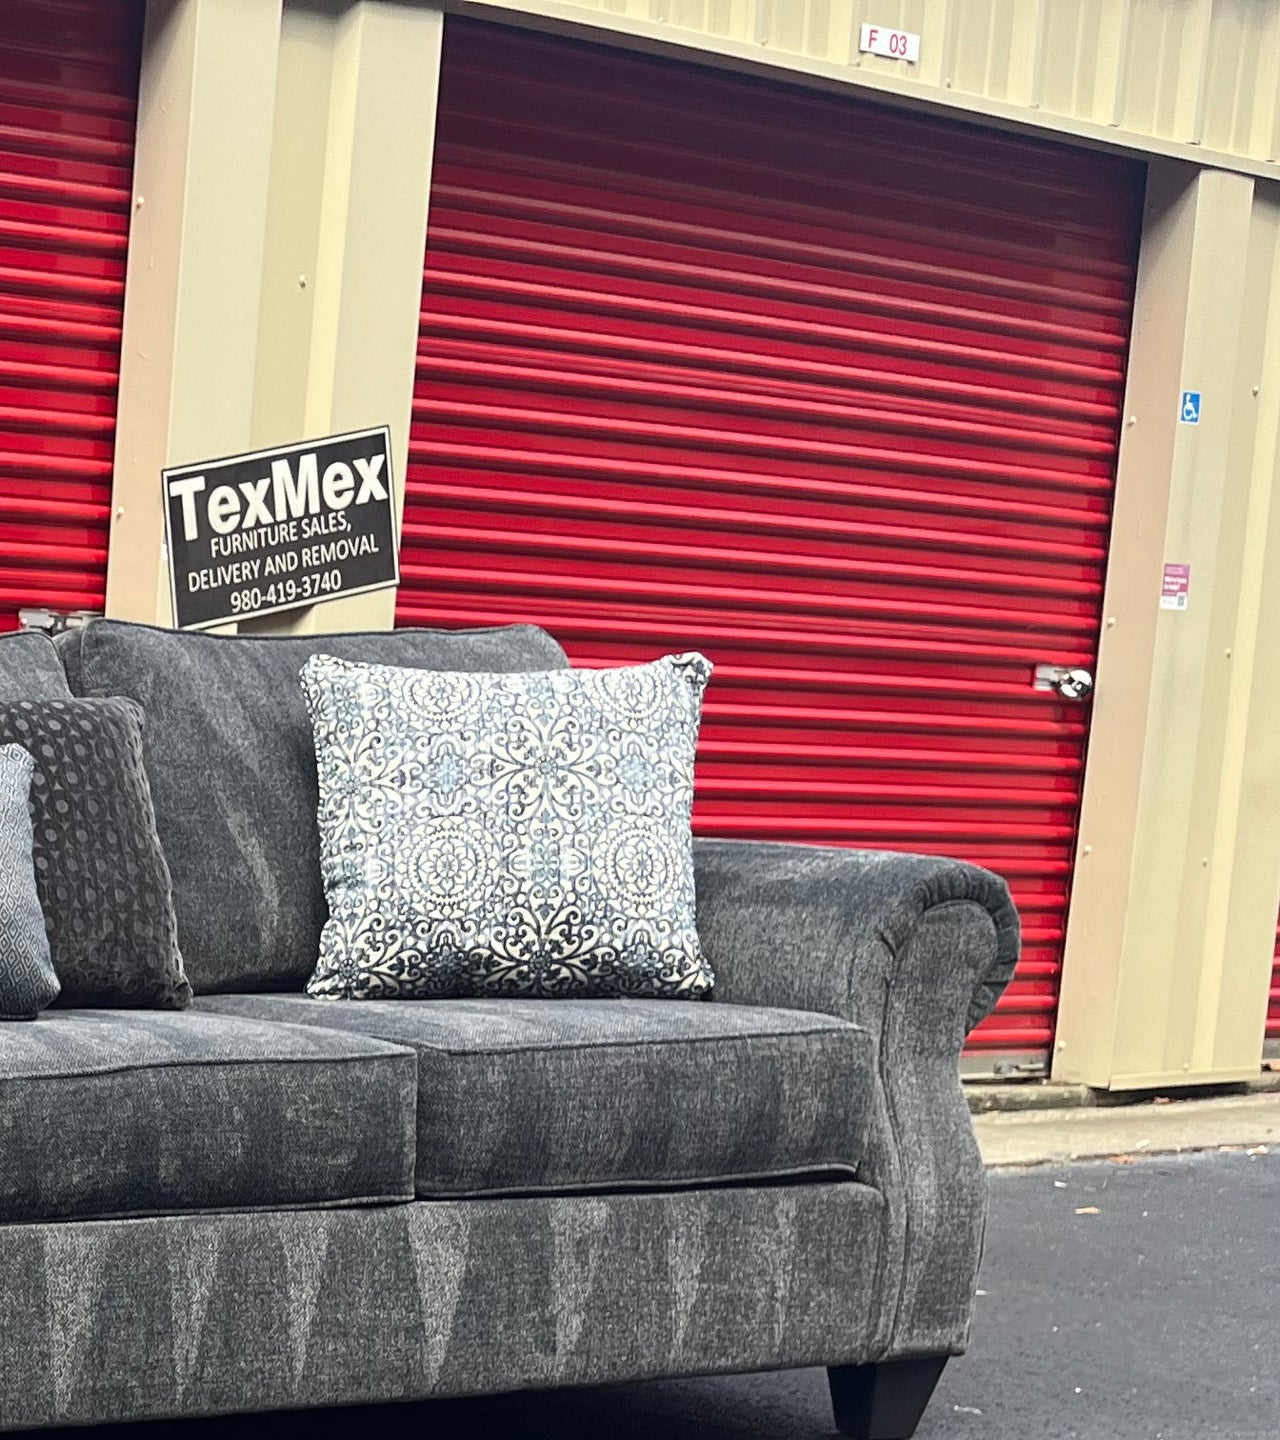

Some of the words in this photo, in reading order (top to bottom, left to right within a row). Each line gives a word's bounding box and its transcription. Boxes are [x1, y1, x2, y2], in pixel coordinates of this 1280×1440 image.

[868, 29, 879, 48] F
[889, 34, 907, 55] 03
[169, 453, 388, 541] TexMex
[210, 520, 298, 558] FURNITURE
[301, 510, 352, 540] SALES,
[188, 557, 262, 592] DELIVERY
[264, 551, 298, 576] AND
[302, 534, 379, 568] REMOVAL
[230, 569, 342, 613] 980-419-3740
